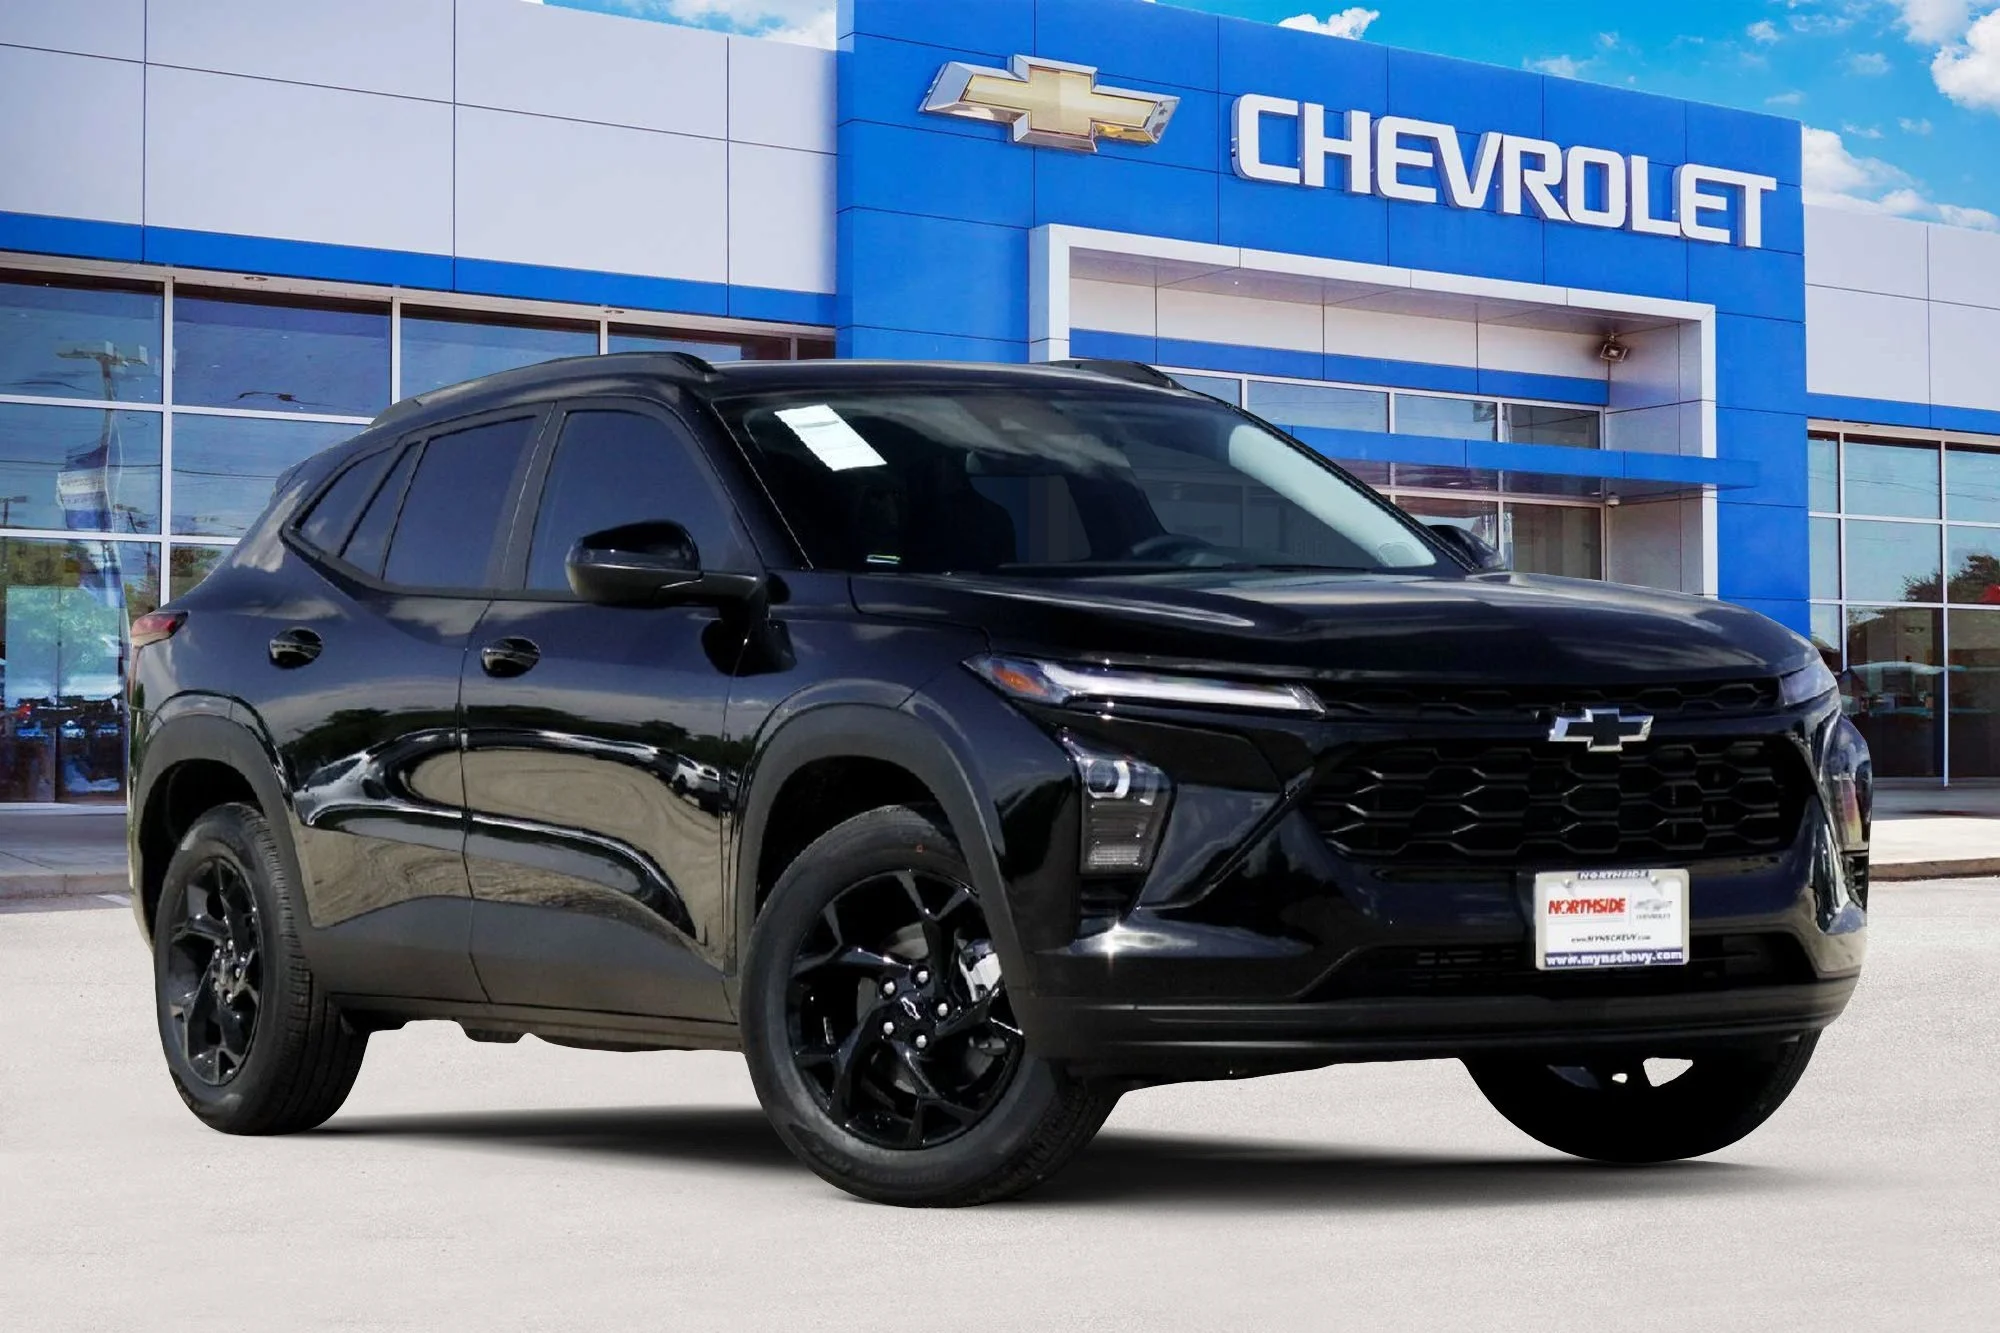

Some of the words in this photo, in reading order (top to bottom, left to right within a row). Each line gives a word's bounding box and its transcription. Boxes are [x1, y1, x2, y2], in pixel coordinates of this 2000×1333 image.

[1231, 93, 1777, 248] CHEVROLET
[1579, 870, 1649, 879] NORTHSIDE
[1548, 897, 1626, 914] NORTHSIDE
[1546, 951, 1682, 965] www.mynschevy.com
